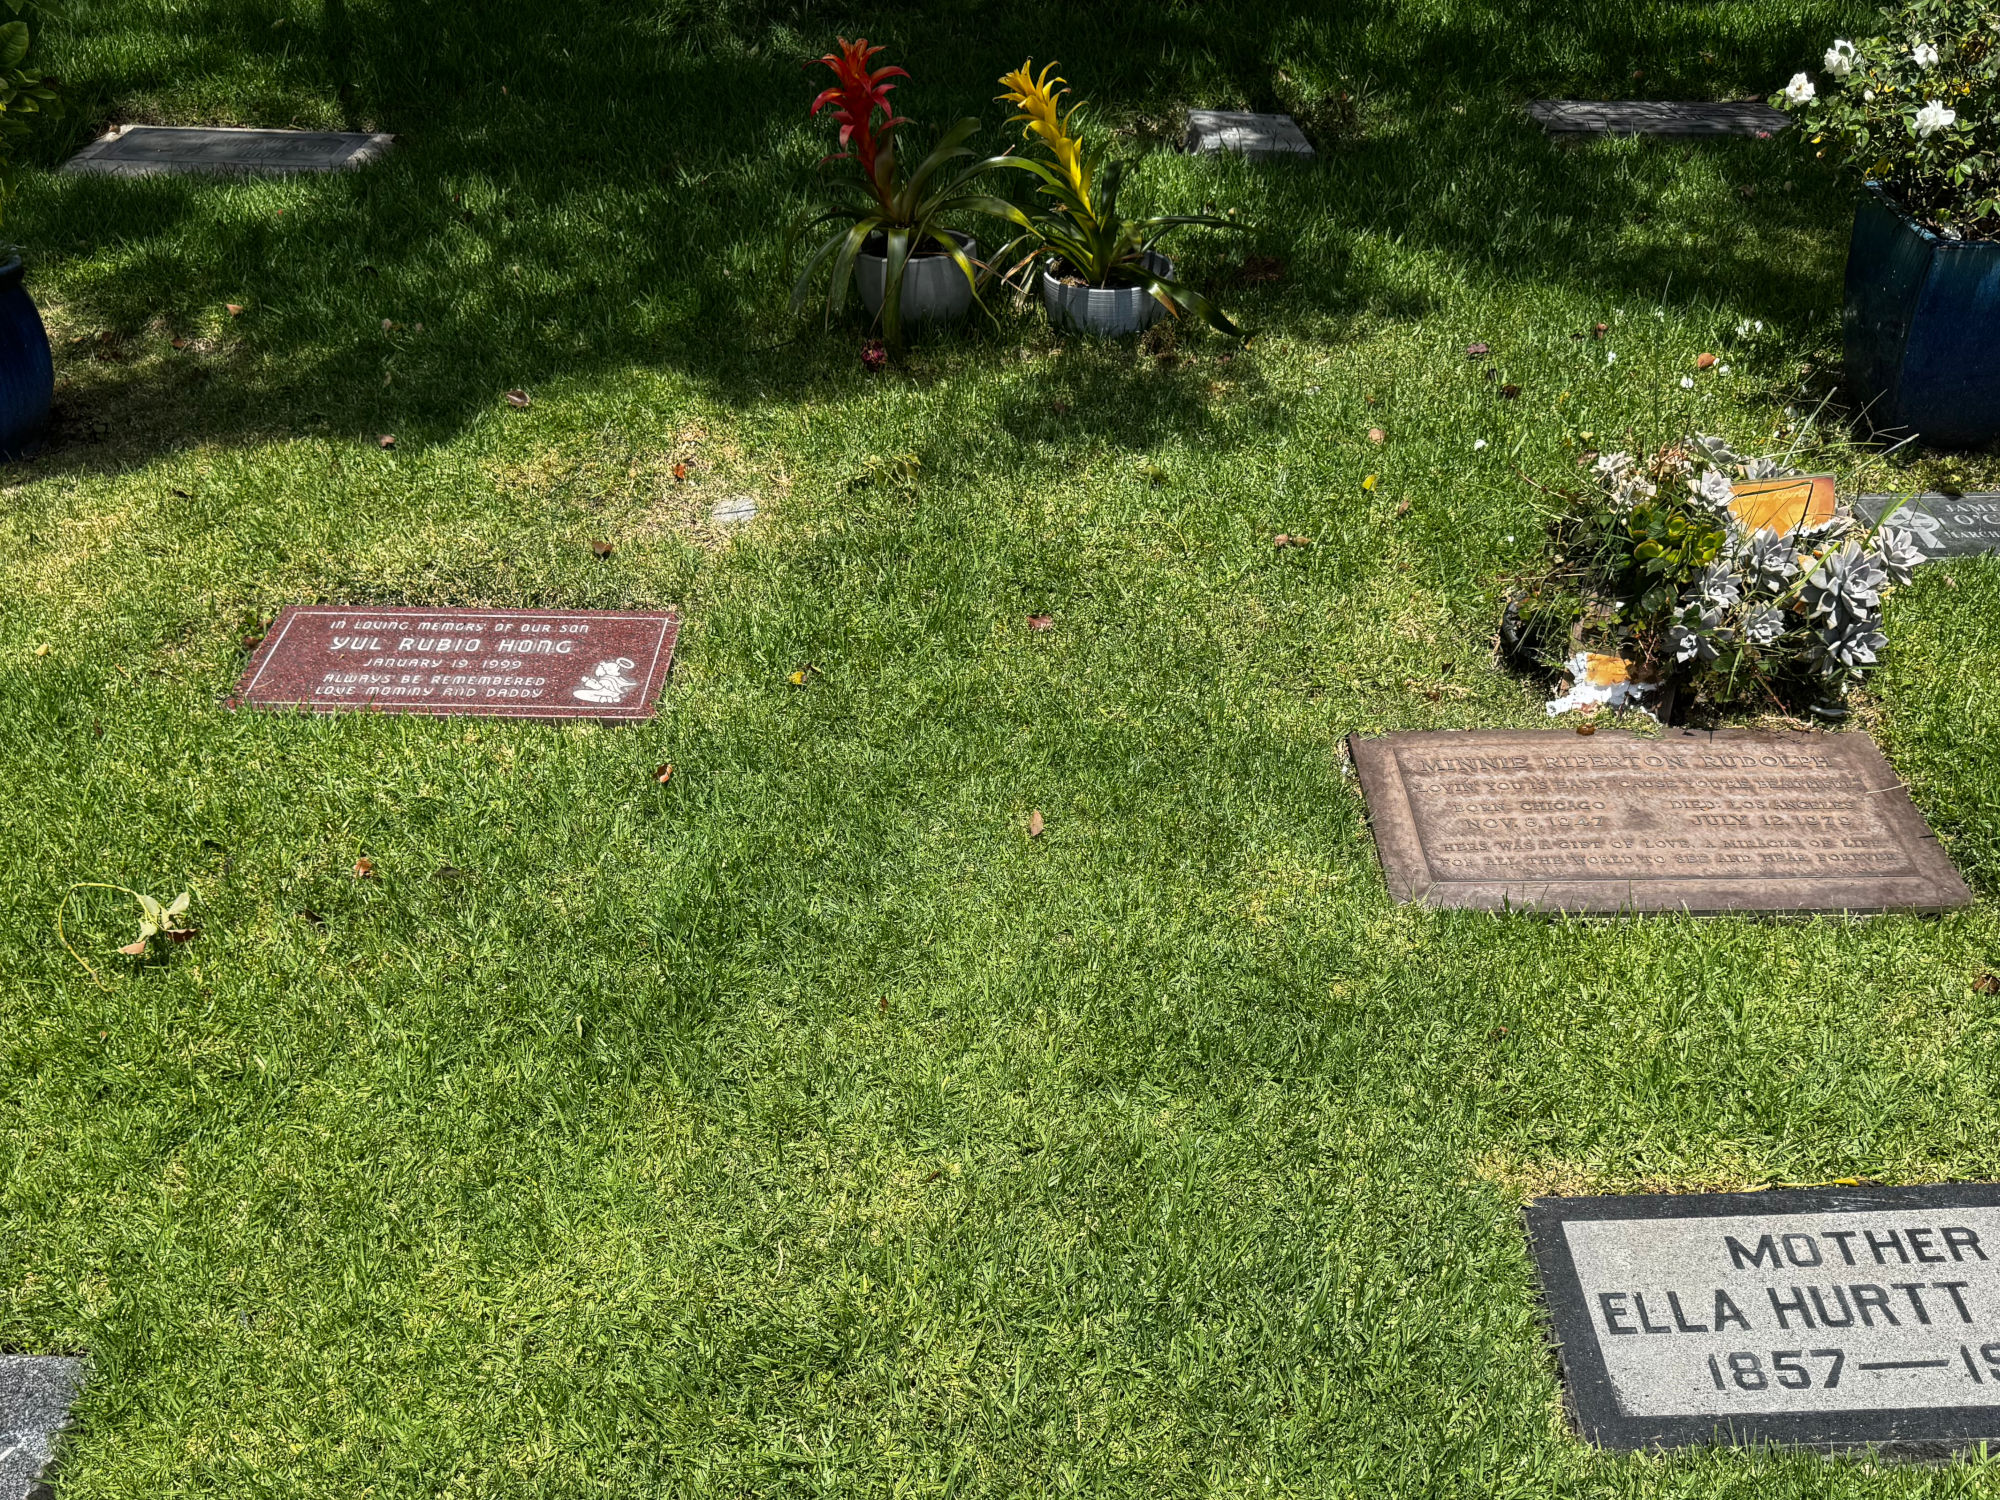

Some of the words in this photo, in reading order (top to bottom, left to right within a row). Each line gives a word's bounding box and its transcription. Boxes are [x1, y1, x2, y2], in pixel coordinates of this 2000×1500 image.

[330, 621, 346, 629] IN
[354, 620, 409, 630] LOVING
[417, 621, 487, 632] MEMORY
[494, 623, 514, 632] OF
[520, 623, 551, 633] OUR
[559, 624, 589, 633] SON
[330, 636, 381, 650] YUL
[398, 638, 481, 652] RUBIO
[498, 639, 572, 654] HONG
[363, 658, 443, 668] JANUARY
[482, 660, 522, 669] 1999
[322, 673, 392, 684] ALWAYS
[400, 675, 422, 684] BE
[430, 674, 546, 687] REMEMBERED
[315, 685, 356, 696] LOVE
[486, 688, 544, 698] DADDY
[1420, 756, 1529, 772] MINNIE
[1544, 754, 1686, 769] RIPERTON
[1701, 754, 1833, 769] RUDOLPH
[1483, 781, 1522, 791] YOU
[1530, 781, 1548, 790] IS
[1554, 779, 1603, 789] EASY
[1520, 800, 1606, 812] CHICAGO
[1729, 800, 1766, 810] LOS
[1774, 800, 1855, 810] ANGELES
[1463, 816, 1519, 829] NOV.
[1691, 815, 1748, 826] JULY
[1793, 814, 1851, 826] 1979
[1444, 843, 1488, 853] HERS
[1496, 841, 1536, 851] WAS
[1557, 840, 1600, 850] GIFT
[1610, 839, 1634, 849] OF
[1704, 839, 1717, 848] A
[1722, 838, 1799, 848] MIRACLE
[1808, 839, 1833, 848] OF
[1439, 858, 1474, 867] FOR
[1484, 856, 1516, 867] ALL
[1526, 856, 1564, 866] THE
[1567, 855, 1634, 866] WORLD
[1636, 854, 1666, 864] TO
[1674, 854, 1710, 864] SEE
[1717, 854, 1752, 863] AND
[1760, 853, 1808, 863] HEAR
[1815, 853, 1900, 862] FOREVER
[1724, 1226, 1989, 1270] MOTHER
[1599, 1289, 1752, 1336] ELLA
[1766, 1281, 1973, 1330] HURTT
[1707, 1348, 1846, 1392] 1857
